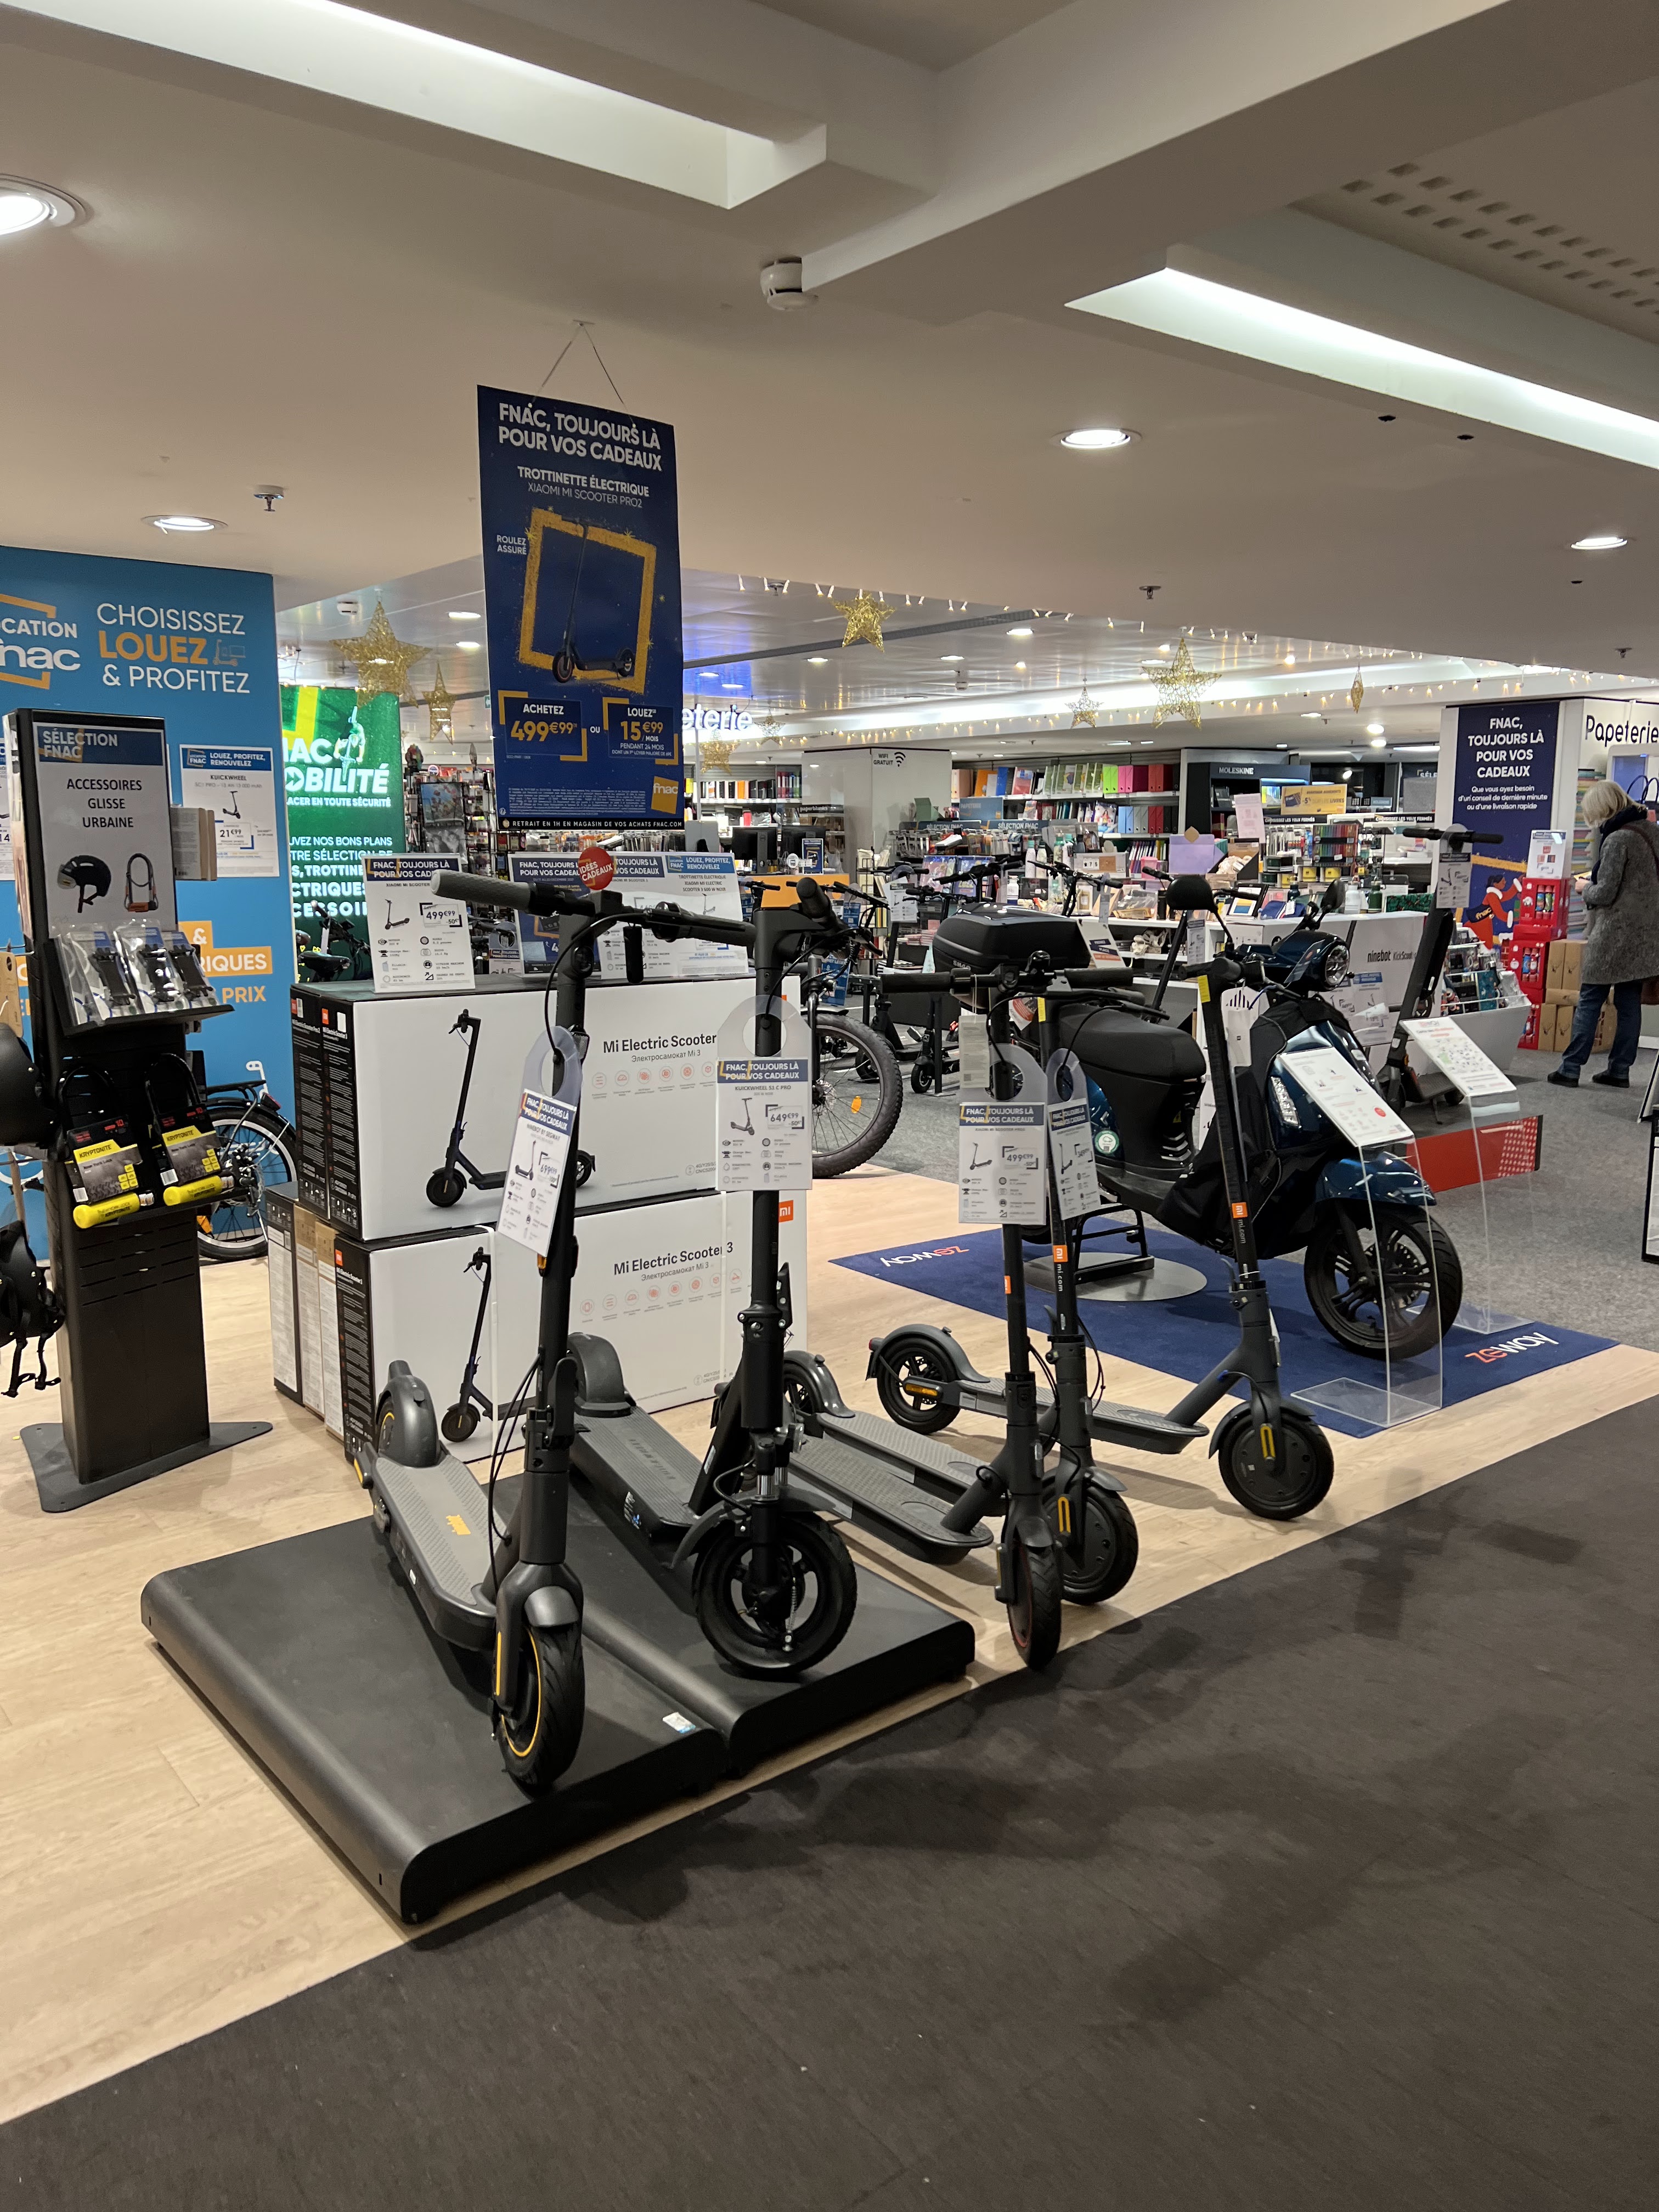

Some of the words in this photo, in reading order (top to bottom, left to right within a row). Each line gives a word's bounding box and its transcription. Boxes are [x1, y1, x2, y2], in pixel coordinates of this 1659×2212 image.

[499, 403, 550, 431] FNAC,
[554, 413, 639, 445] TOUJOURS
[642, 428, 661, 449] LÀ
[499, 426, 547, 451] POUR
[551, 435, 586, 457] VOS
[590, 442, 662, 471] CADEAUX
[517, 466, 587, 487] TROTTINETTE
[590, 475, 649, 496] ÉLECTRIQUE
[528, 482, 560, 495] XIAOMI
[562, 488, 572, 498] MI
[574, 489, 617, 505] SCOOTER
[620, 496, 642, 508] PRO2
[496, 535, 526, 545] ROULEZ
[497, 544, 527, 555] ASSURÉ
[97, 603, 245, 635] CHOISISSEZ
[0, 618, 77, 639] CATION
[99, 631, 207, 664] LOUEZ
[103, 664, 121, 687] &
[129, 667, 250, 693] PROFITEZ
[523, 704, 564, 715] ACHETEZ
[1490, 717, 1523, 729] FNAC,
[1585, 715, 1658, 747] Papeterie
[42, 729, 118, 747] SÉLECTION
[1468, 733, 1527, 746] TOUJOURS
[1530, 730, 1544, 743] LÀ
[44, 745, 82, 759] FNAC
[1476, 750, 1506, 762] POUR
[1509, 749, 1533, 760] VOS
[284, 763, 389, 793] OBILITÉ
[1477, 766, 1530, 777] CADEAUX
[67, 778, 142, 791] ACCESSOIRES
[653, 783, 678, 794] fnac
[88, 798, 126, 809] GLISSE
[324, 798, 351, 806] TOUTE
[353, 796, 391, 807] SÉCURITÉ
[82, 816, 134, 828] URBAINE
[313, 837, 334, 845] NOS
[336, 837, 362, 845] BONS
[364, 837, 393, 846] PLANS
[440, 860, 450, 868] LÀ
[579, 861, 598, 874] IDÉES
[616, 857, 649, 866] TOUJOURS
[650, 857, 658, 866] LÀ
[582, 863, 613, 882] CADEAUX
[1476, 907, 1492, 919] fnac
[193, 928, 207, 944] &
[1368, 950, 1391, 962] ninebot
[222, 986, 266, 1003] PRIX
[603, 1040, 619, 1053] Mi
[622, 1036, 669, 1052] Electric
[671, 1034, 717, 1047] Scooter
[631, 1052, 686, 1063] Электросамокат
[540, 1102, 563, 1118] TOUJOURS
[546, 1115, 568, 1131] CADEAUX
[167, 1130, 194, 1142] KRYPTONITE
[80, 1144, 111, 1158] KRYPTONITE
[1238, 1219, 1246, 1244] mi.com
[614, 1261, 629, 1276] Mi
[632, 1253, 678, 1272] Electric
[726, 1242, 733, 1253] 3
[880, 1246, 970, 1267] zeway
[641, 1265, 695, 1281] Электросамокат
[1464, 1332, 1559, 1364] zeway
